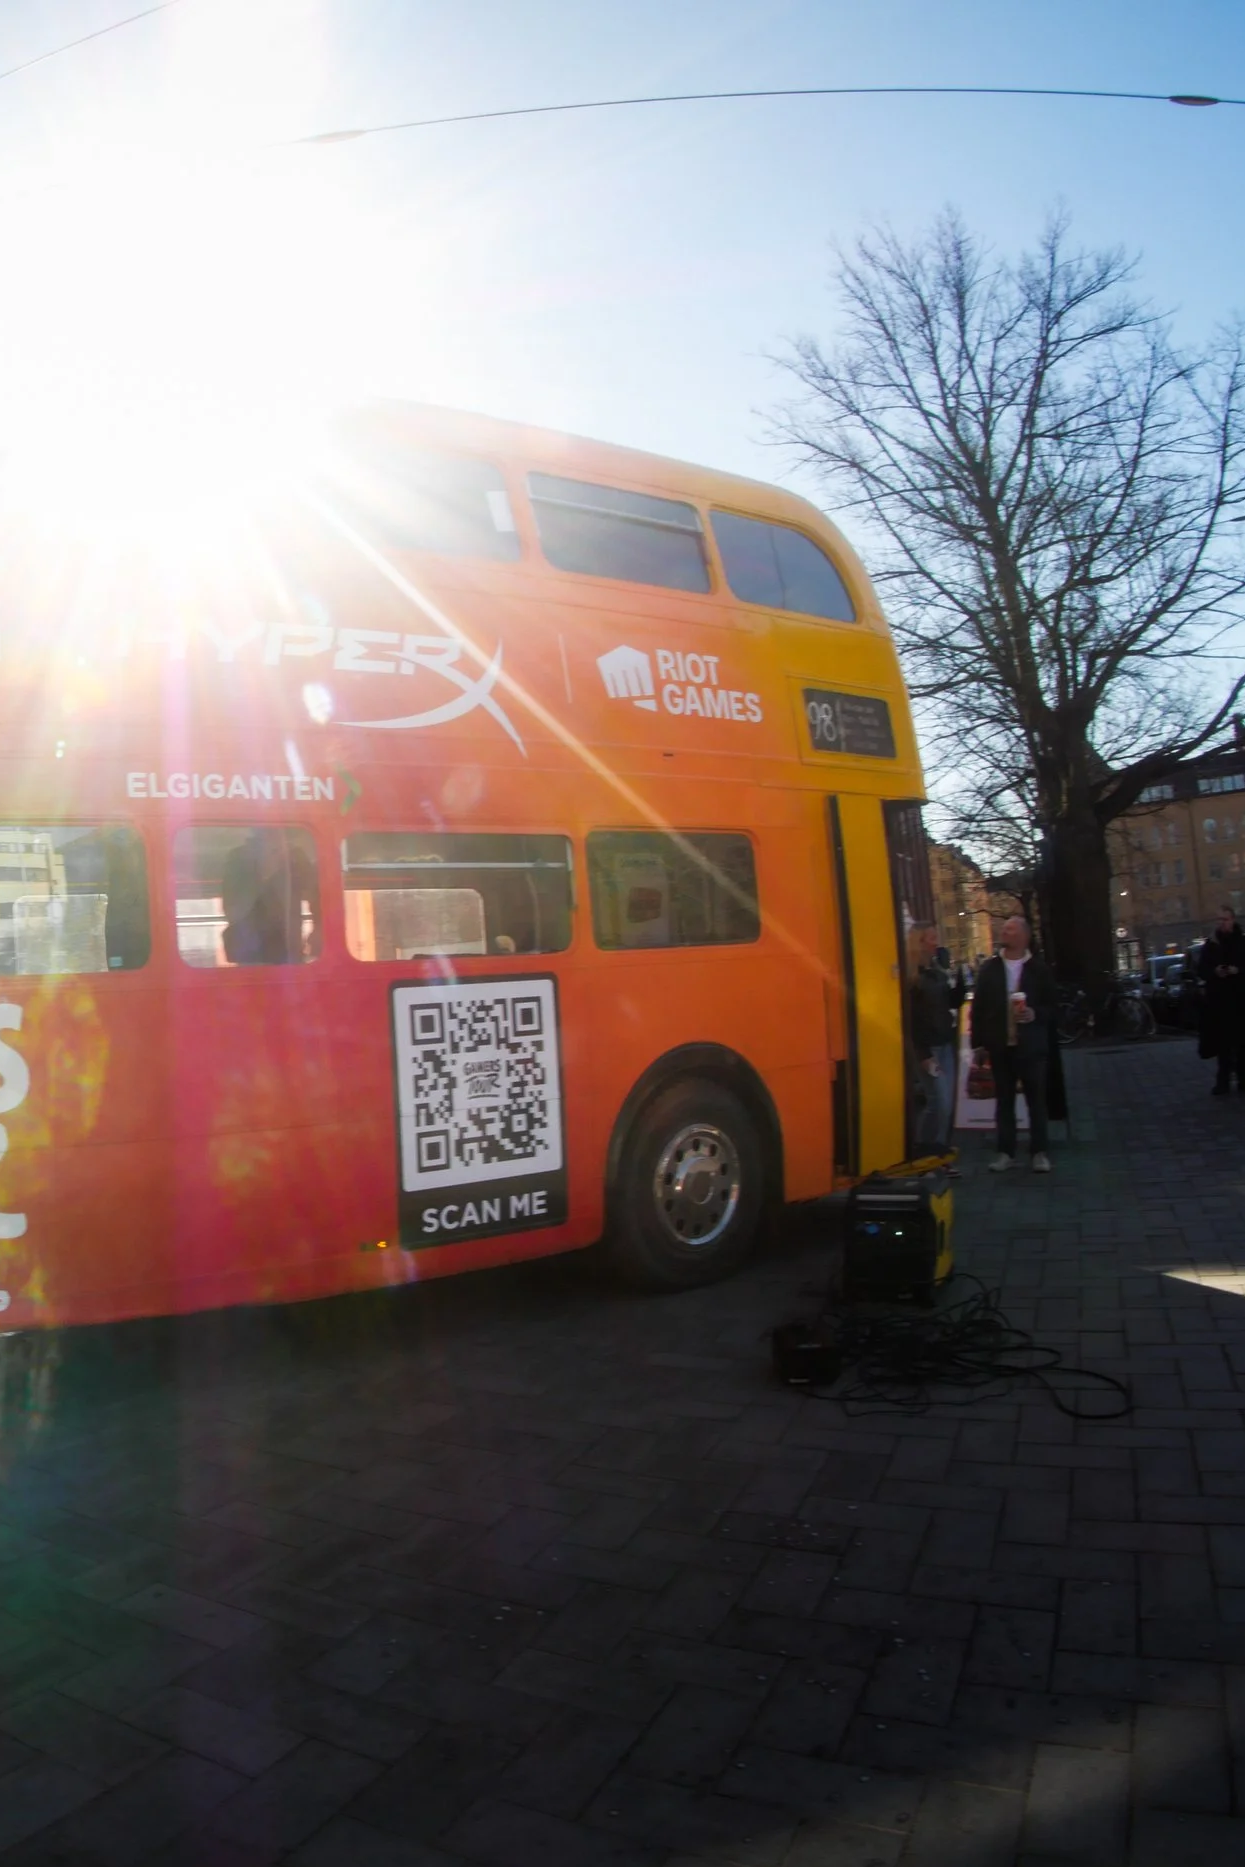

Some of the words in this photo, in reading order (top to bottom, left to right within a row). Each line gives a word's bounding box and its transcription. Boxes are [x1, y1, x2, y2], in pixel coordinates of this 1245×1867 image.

[656, 648, 719, 685] RIOT
[662, 684, 762, 723] GAMES
[808, 701, 837, 741] 98
[127, 772, 334, 801] ELGIGANTEN
[421, 1198, 501, 1233] SCAN
[509, 1190, 548, 1218] ME
